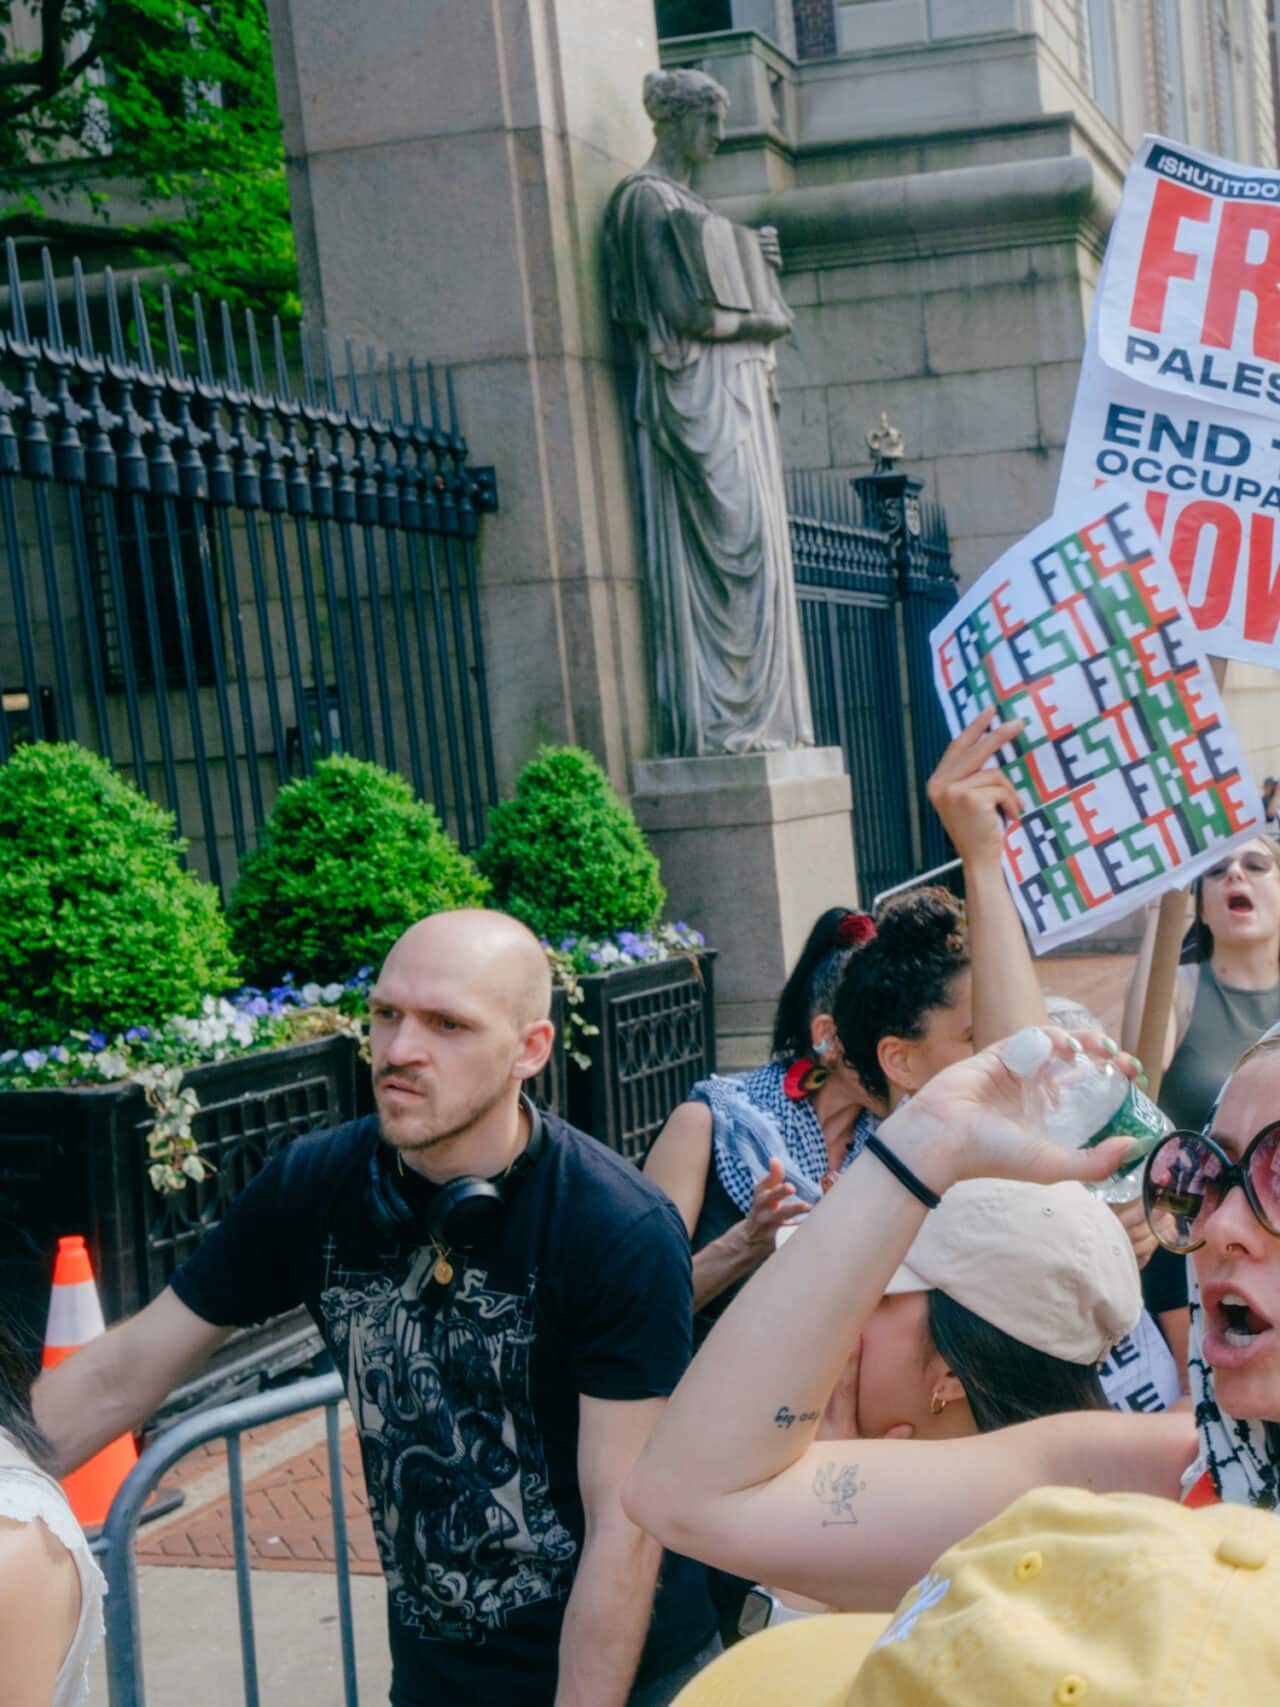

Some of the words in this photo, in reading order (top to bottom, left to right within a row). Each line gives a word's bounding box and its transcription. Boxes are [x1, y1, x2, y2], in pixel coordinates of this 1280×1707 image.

[1103, 404, 1252, 466] END
[1030, 501, 1151, 605] FREE
[1079, 614, 1199, 714] FREE
[1001, 666, 1219, 814] ALESTINE
[1119, 720, 1238, 820] FREE
[1019, 772, 1257, 933] PALESTINE
